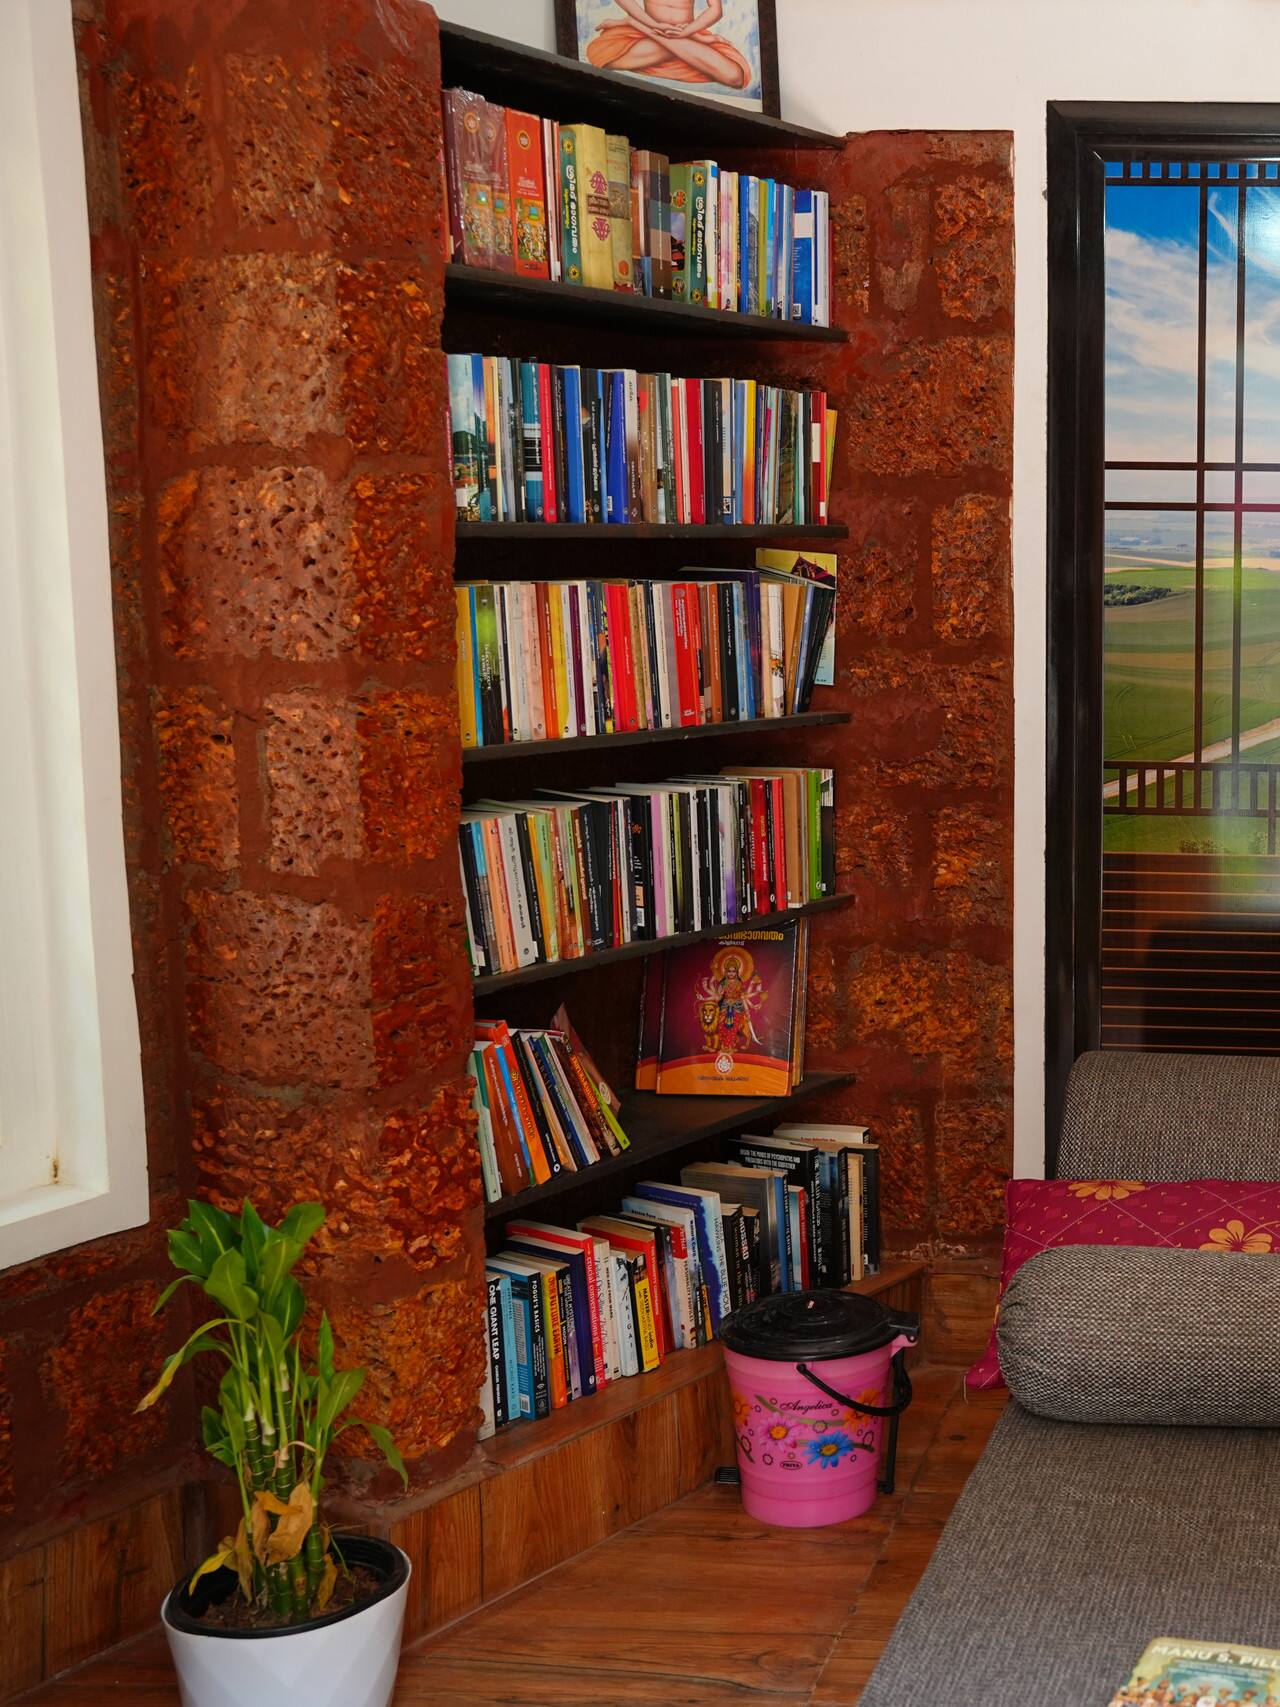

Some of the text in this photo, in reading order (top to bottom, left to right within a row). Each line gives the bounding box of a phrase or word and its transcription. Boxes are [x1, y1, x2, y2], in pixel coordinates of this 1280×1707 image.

[739, 1216, 750, 1261] MOSSAD
[720, 1269, 728, 1289] BLUE
[531, 1279, 541, 1333] POGUE'S BASICS
[549, 1295, 559, 1329] FUTURE
[586, 1256, 599, 1338] crucial conversations
[723, 1290, 731, 1314] HOUR
[489, 1284, 501, 1360] ONE GIANT LEAP
[552, 1329, 562, 1355] EARTH
[780, 1400, 833, 1415] Angelica
[1150, 1644, 1214, 1660] MANU
